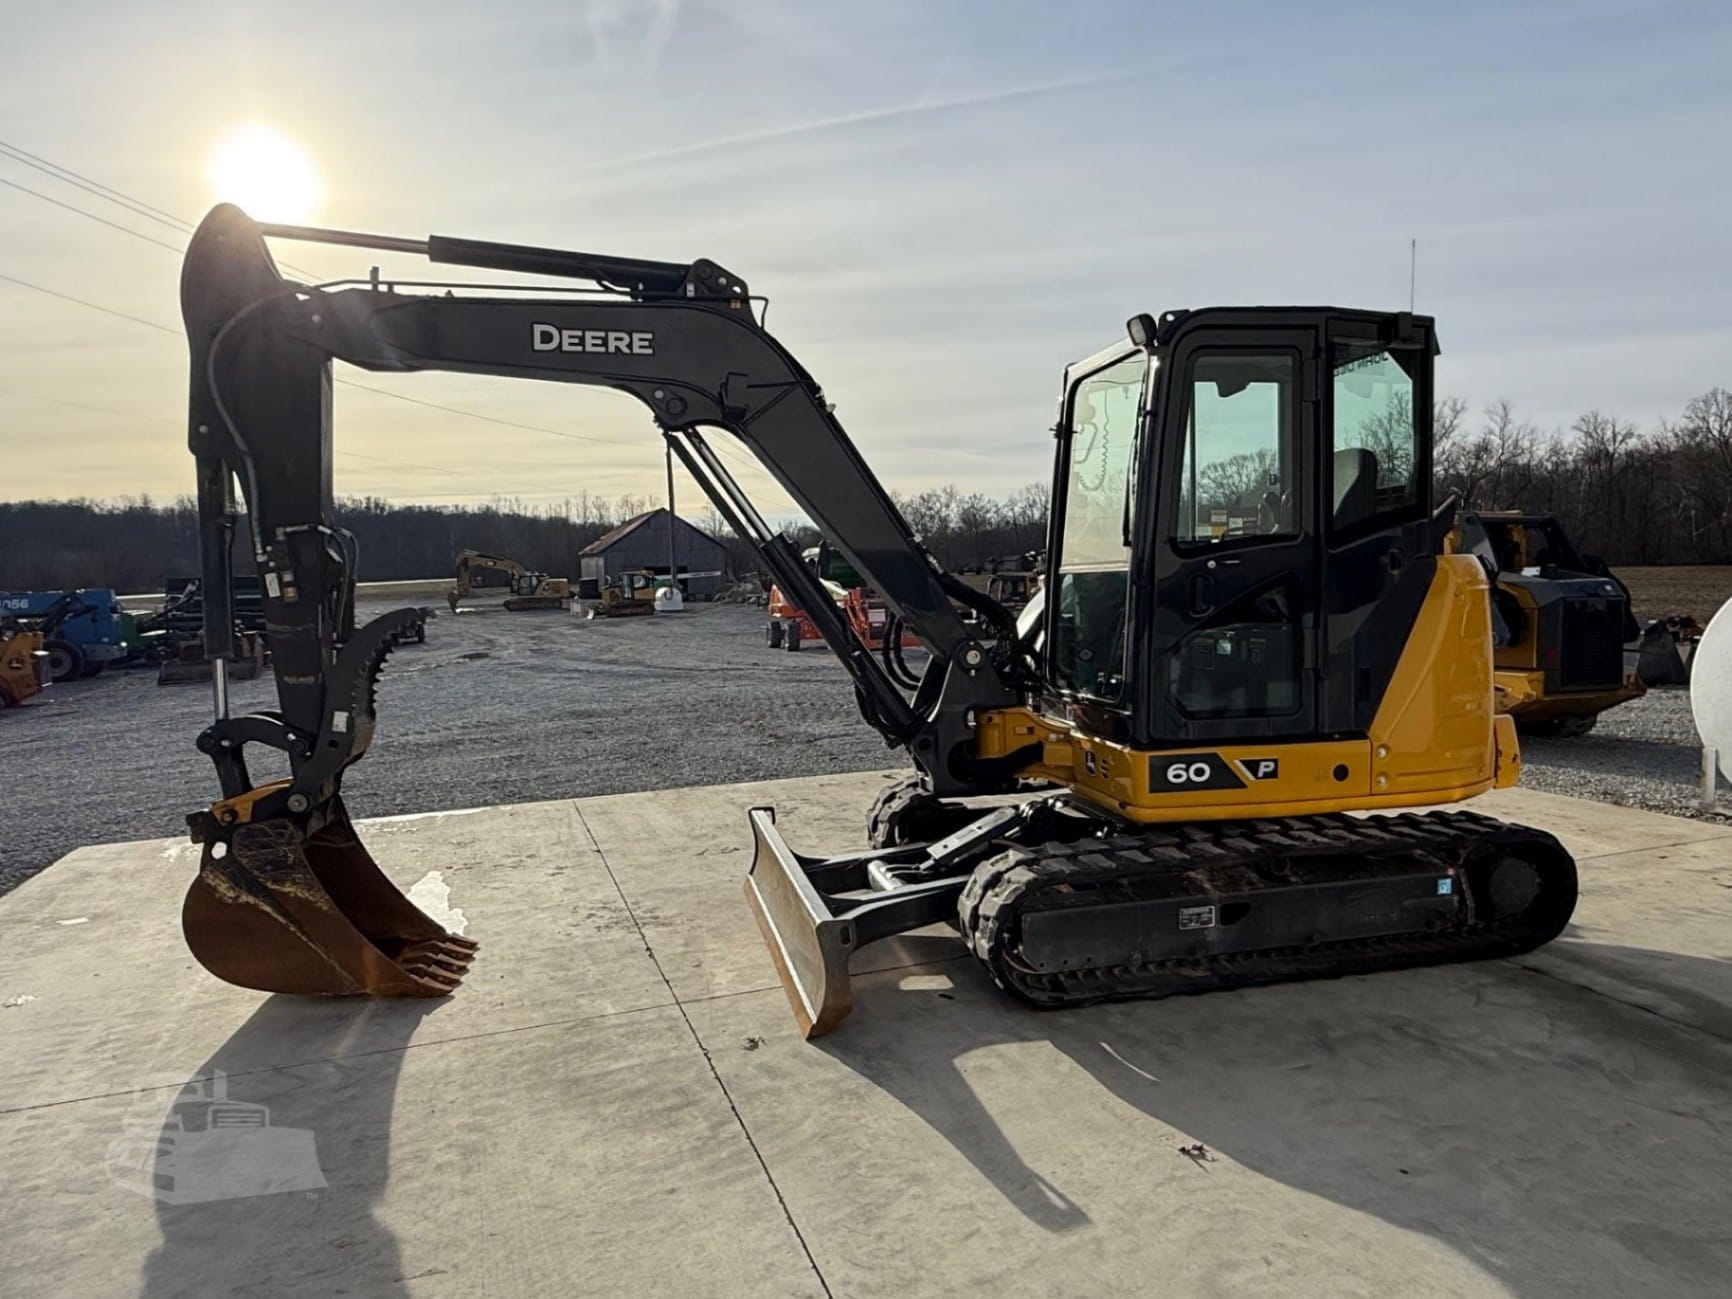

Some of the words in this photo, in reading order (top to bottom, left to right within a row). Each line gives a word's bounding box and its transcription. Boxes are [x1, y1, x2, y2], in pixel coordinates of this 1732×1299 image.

[533, 324, 653, 354] DEERE
[1167, 763, 1211, 783] 60
[1257, 761, 1275, 777] P
